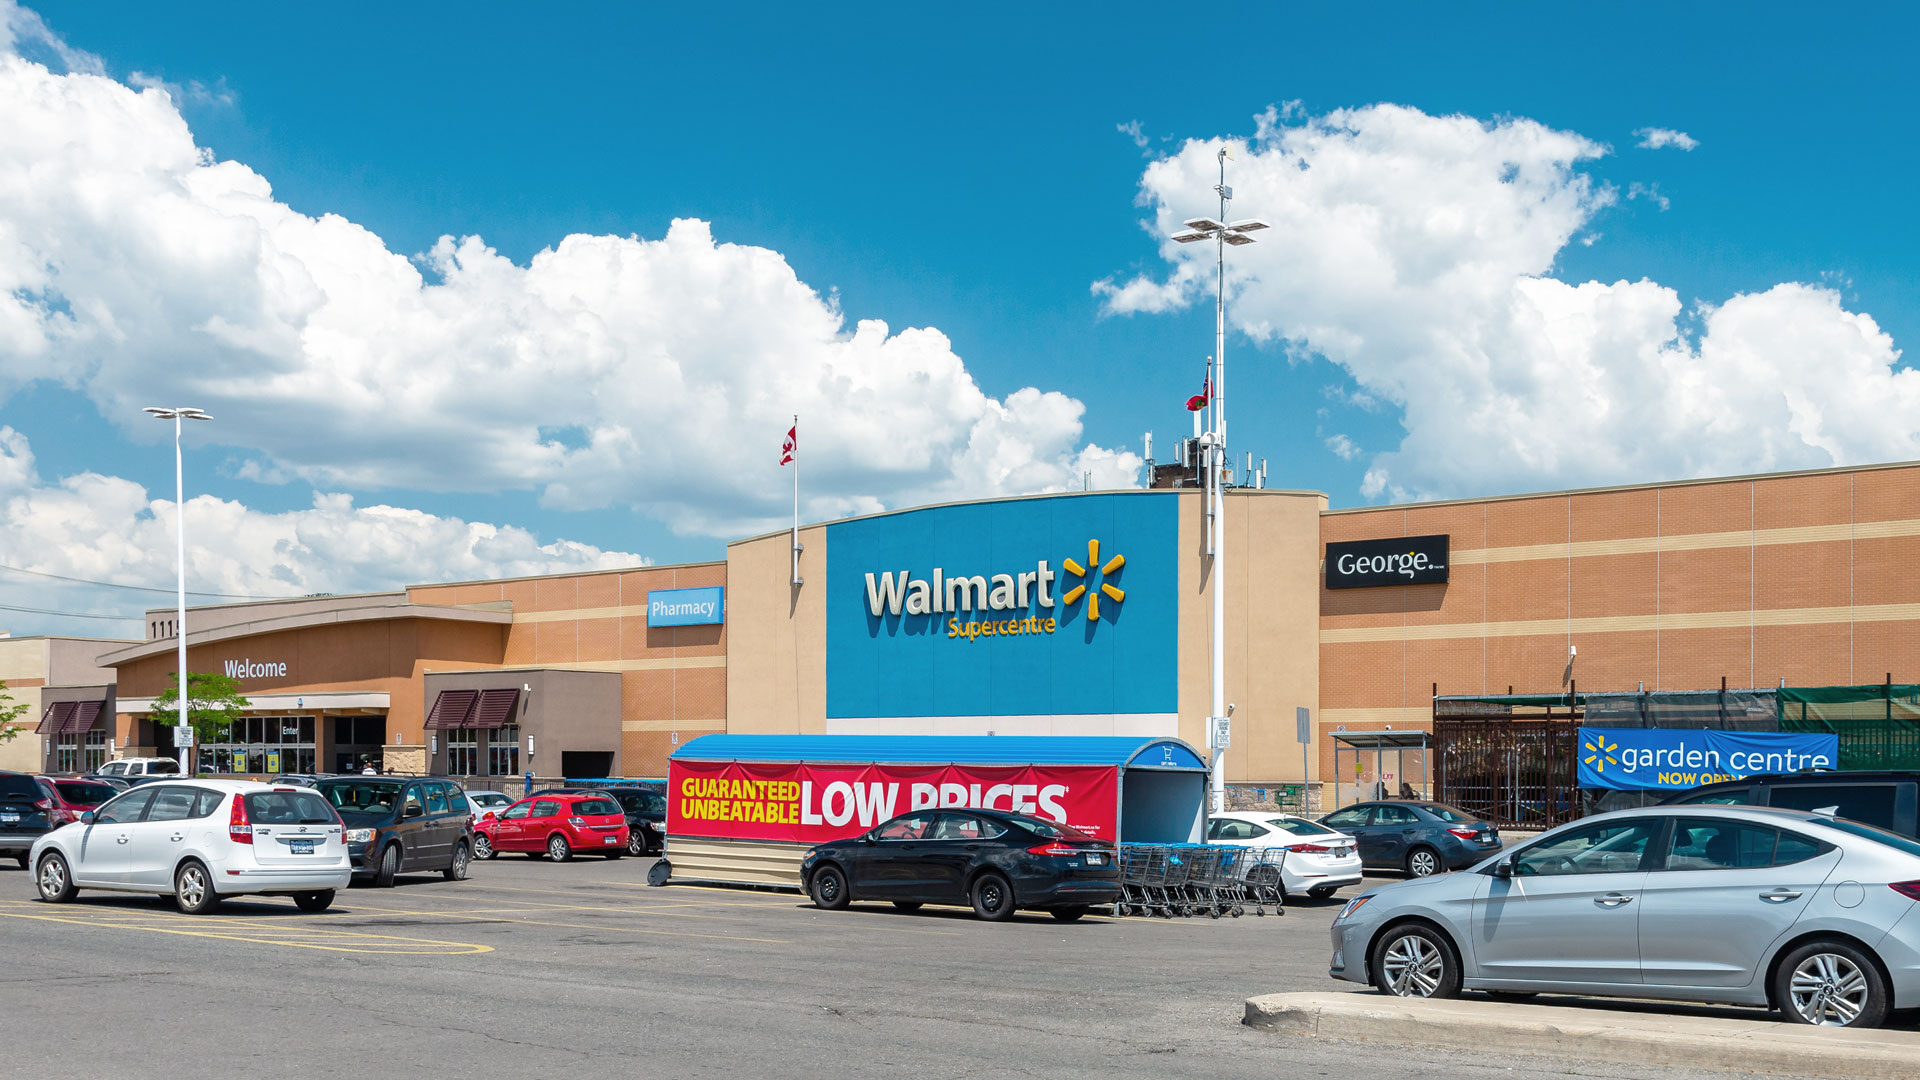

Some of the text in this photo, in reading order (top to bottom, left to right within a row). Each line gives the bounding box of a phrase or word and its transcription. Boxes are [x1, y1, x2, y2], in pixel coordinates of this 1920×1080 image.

[864, 560, 1056, 617] Walmart
[652, 600, 715, 618] Pharmacy
[947, 615, 1056, 642] Supercentre
[224, 658, 287, 679] Welcome
[282, 726, 299, 736] Enter
[1621, 742, 1830, 773] garden centre
[681, 777, 801, 801] GUARANTEED
[1658, 772, 1698, 785] NOW
[680, 798, 800, 825] UNBEATABLE
[801, 780, 900, 827] LOW
